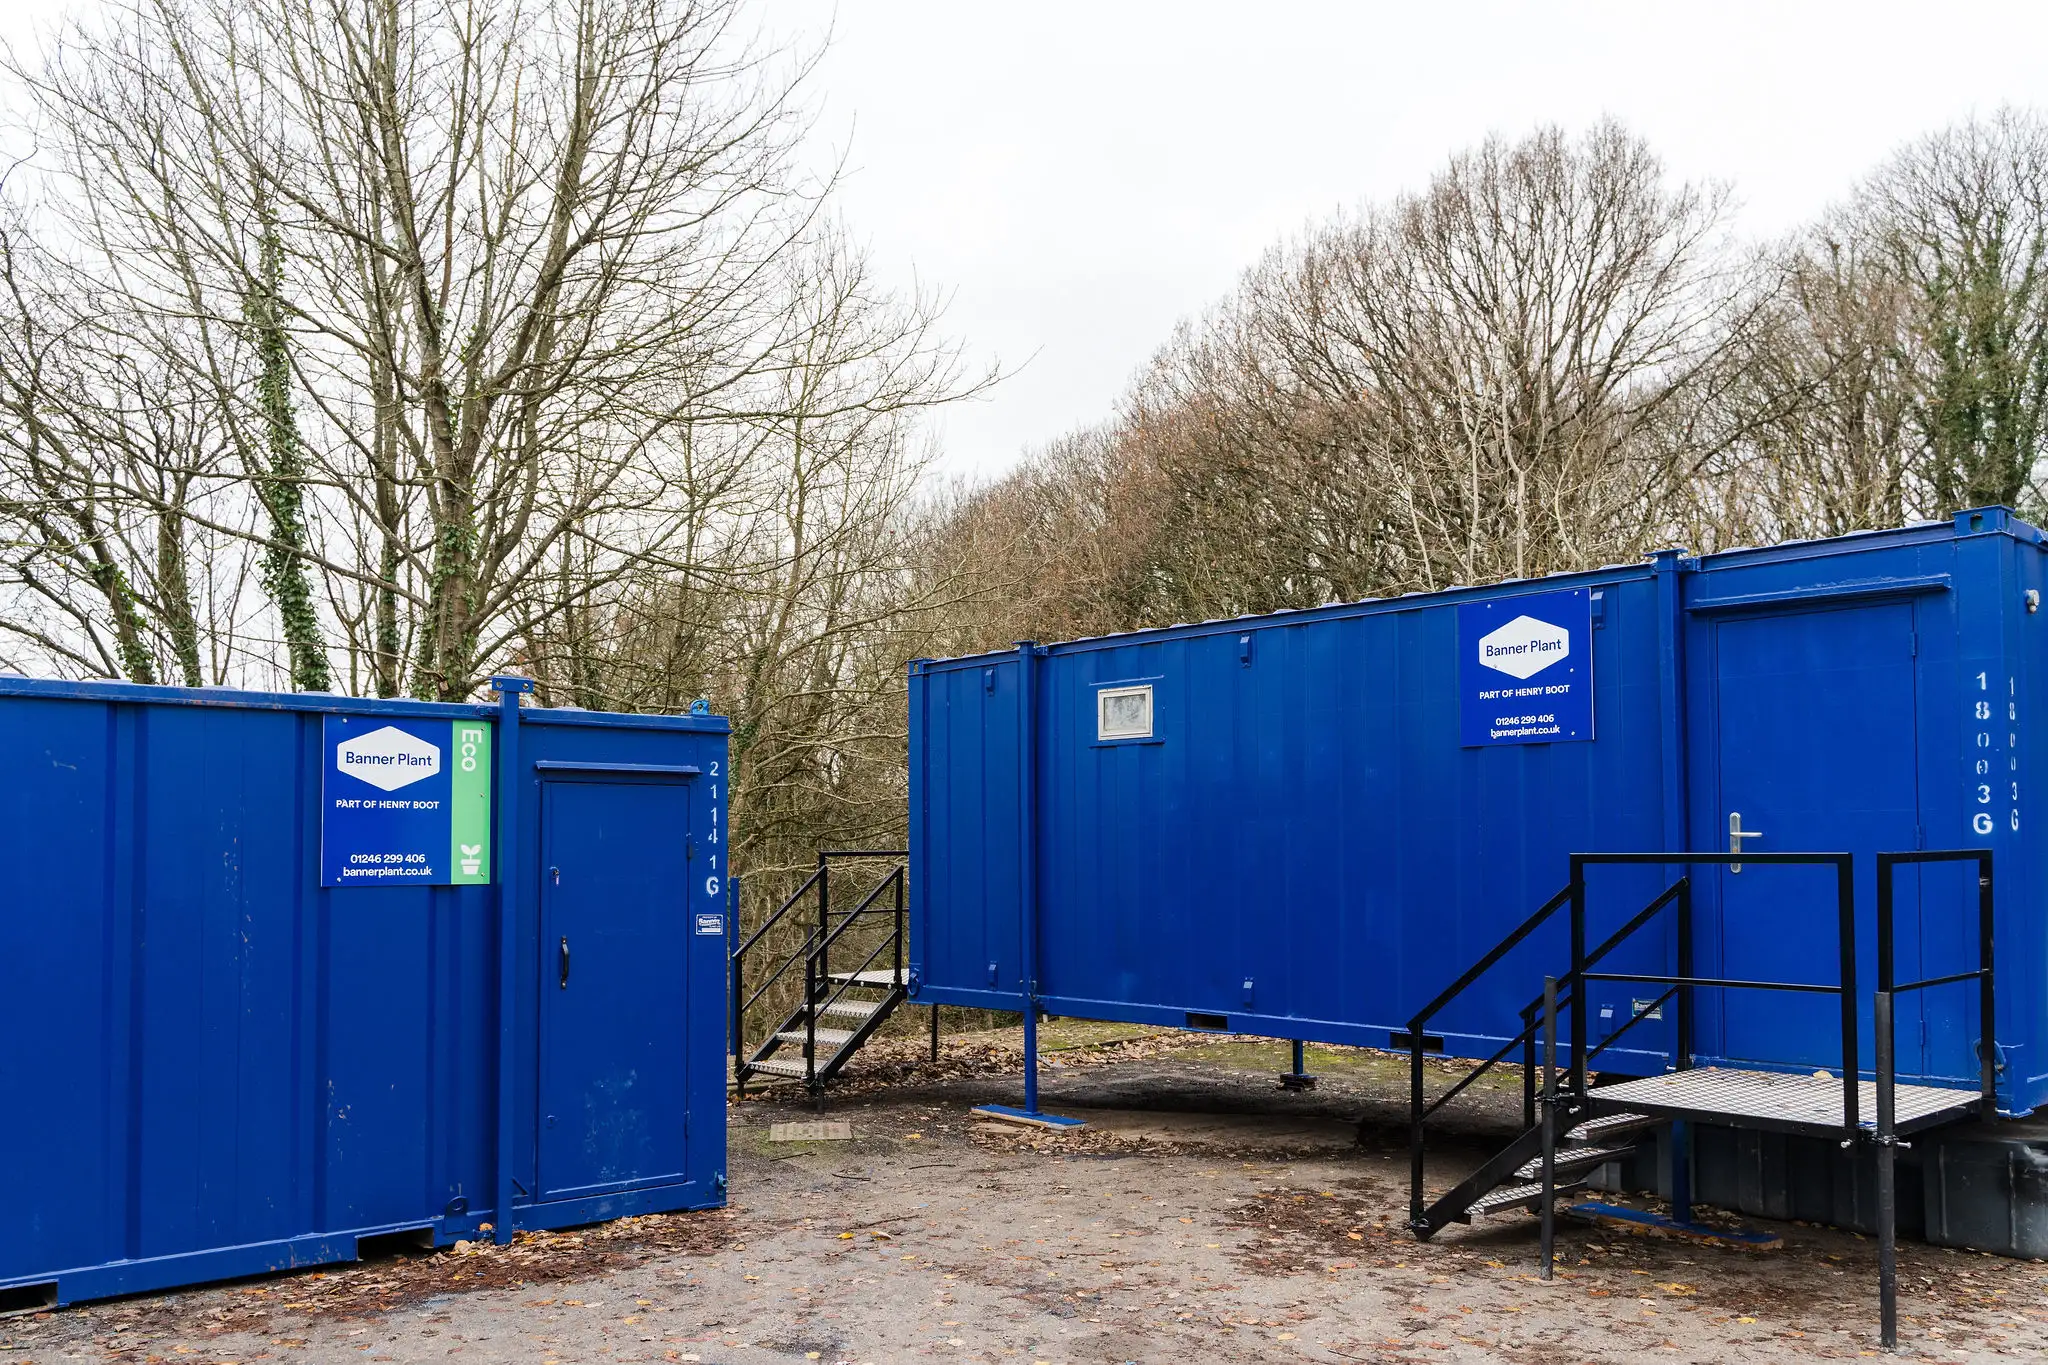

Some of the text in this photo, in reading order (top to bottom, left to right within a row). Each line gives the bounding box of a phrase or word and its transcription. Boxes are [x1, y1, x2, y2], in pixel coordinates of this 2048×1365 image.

[1486, 639, 1562, 657] Banner Plant
[1479, 685, 1570, 700] PART OF HENRY BOOT
[1495, 713, 1555, 726] 01246 299 406
[1490, 724, 1561, 738] bannerplant.co.uk
[461, 729, 482, 772] Eco
[1972, 671, 1994, 835] 18003G
[346, 751, 432, 767] Banner Plant
[335, 799, 440, 810] PART OF HENRY BOOT
[705, 761, 720, 898] 21141G
[350, 854, 426, 864] 01246 299 406
[343, 866, 432, 878] bannerplant.co.uk
